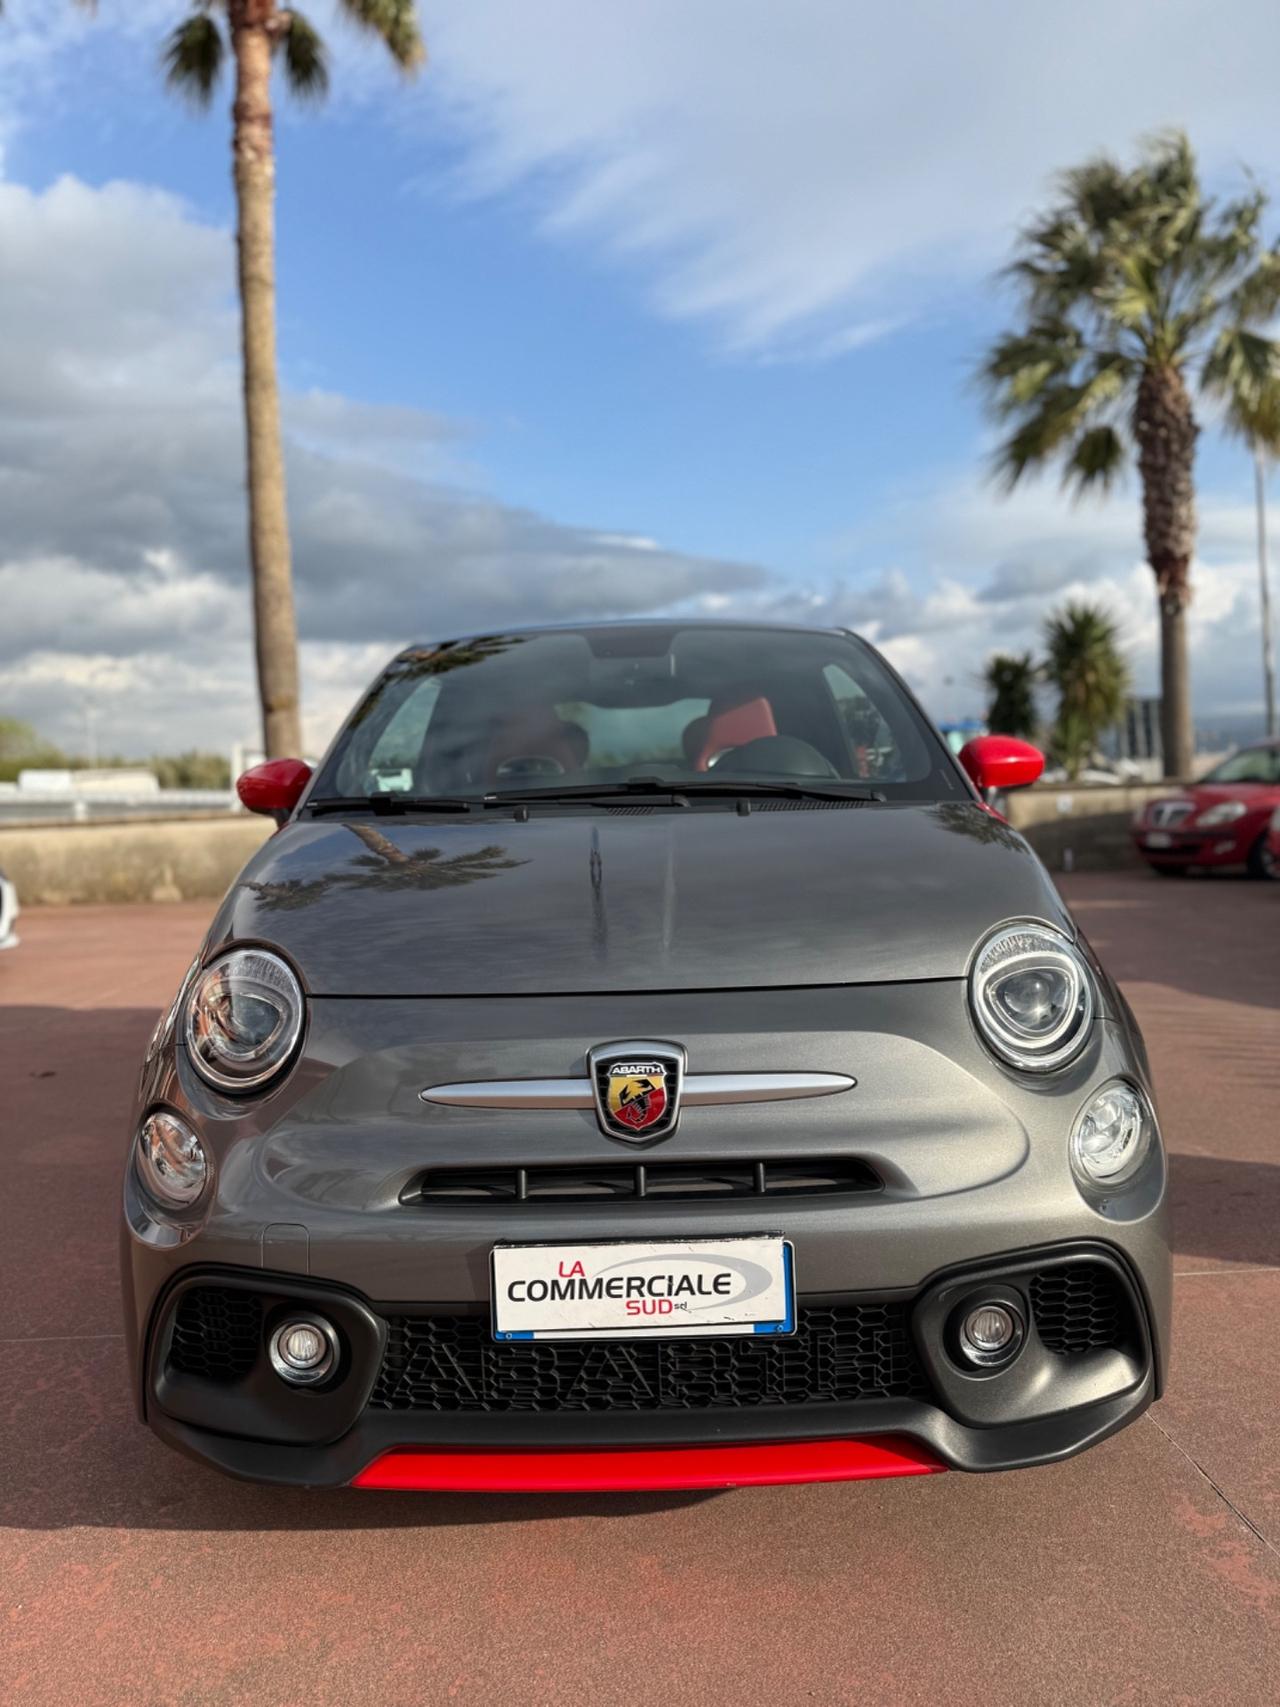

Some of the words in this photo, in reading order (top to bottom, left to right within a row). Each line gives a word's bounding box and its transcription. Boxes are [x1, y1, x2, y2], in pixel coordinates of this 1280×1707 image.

[612, 1066, 661, 1074] ABARTH
[558, 1261, 585, 1278] LA
[507, 1272, 732, 1302] COMMERCIALE
[625, 1299, 673, 1315] SUD
[392, 1331, 893, 1399] ABARTH
